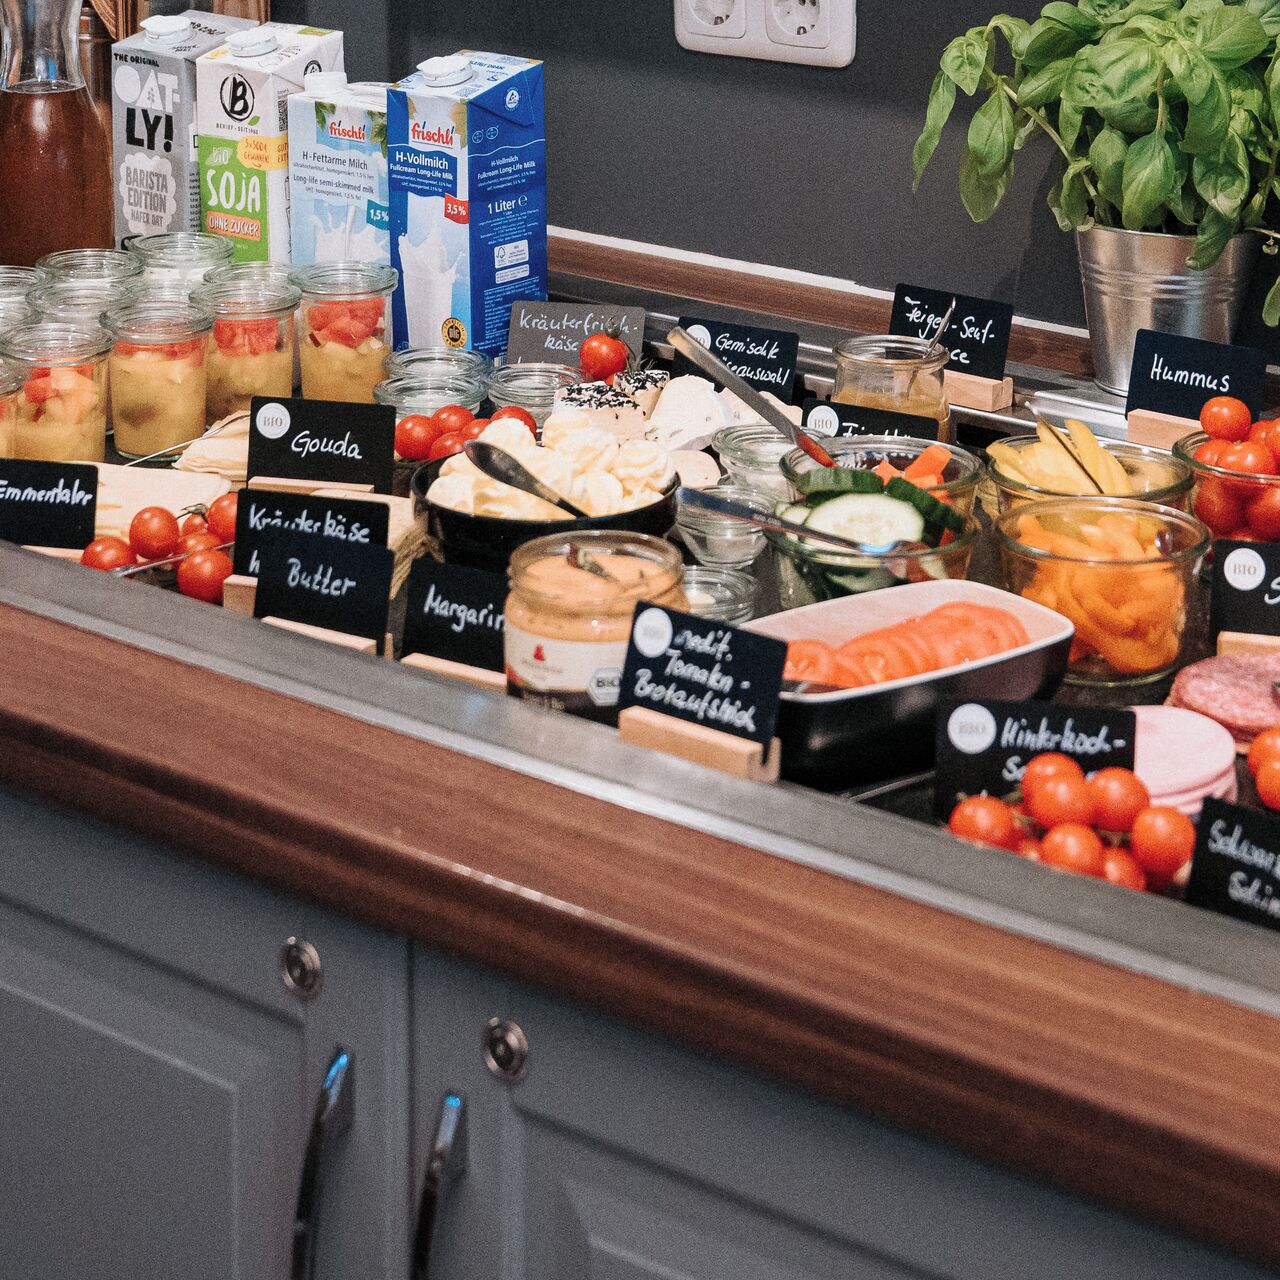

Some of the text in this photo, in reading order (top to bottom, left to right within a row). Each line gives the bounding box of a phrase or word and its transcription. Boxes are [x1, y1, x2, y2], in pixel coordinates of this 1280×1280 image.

[113, 53, 160, 67] THE ORIGINAL
[229, 76, 249, 116] B
[126, 107, 174, 152] LY!
[329, 120, 366, 141] frischli
[411, 121, 455, 146] frischli
[348, 156, 368, 170] Milch
[396, 151, 449, 170] H-Vollmilch
[523, 160, 536, 169] Milk
[125, 166, 169, 194] BARISTA
[390, 163, 454, 180] Fullcream Long-Life Milk
[362, 185, 375, 194] milk
[127, 187, 167, 214] EDITION
[495, 198, 517, 213] Liter
[130, 209, 150, 225] HAFER
[209, 215, 259, 238] OHNE ZUCKER
[519, 309, 638, 335] Kräuterfrih-
[1150, 353, 1230, 392] Hummus
[263, 416, 283, 427] BIO
[814, 418, 833, 430] BIO
[291, 430, 363, 458] Gouda
[287, 557, 357, 597] Butter
[1233, 563, 1257, 576] BIO
